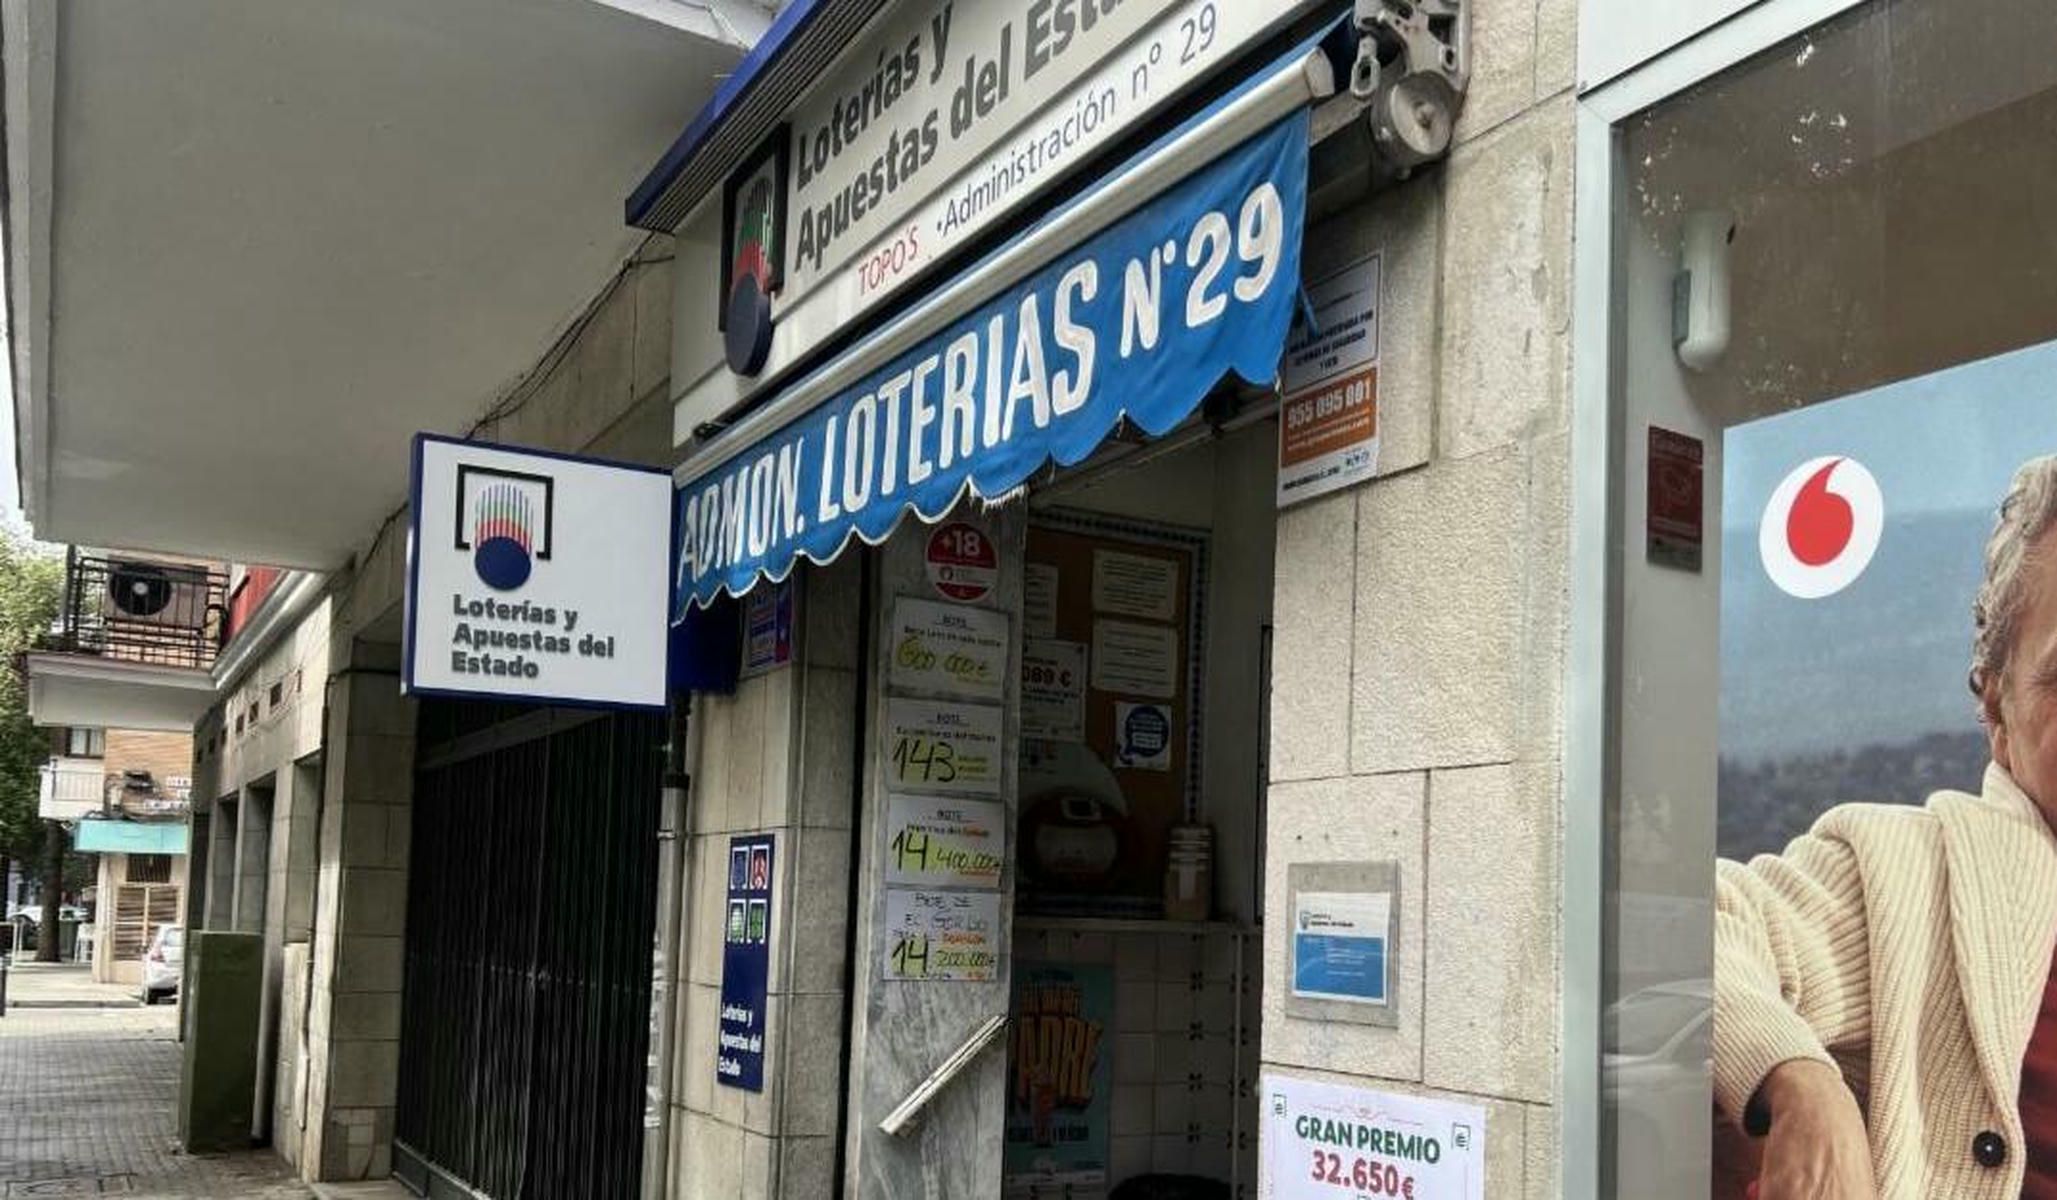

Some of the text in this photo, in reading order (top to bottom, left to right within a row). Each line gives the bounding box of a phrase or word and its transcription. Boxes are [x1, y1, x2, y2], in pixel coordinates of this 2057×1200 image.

[1180, 3, 1217, 67] 29
[797, 3, 953, 191] Loterías y
[795, 105, 938, 273] Apuestas
[950, 22, 1011, 140] del
[676, 436, 805, 589] ADMON.
[818, 258, 1099, 525] LOTERIAS
[1185, 181, 1284, 329] 29
[453, 593, 579, 633] Loterías y
[451, 650, 540, 679] Estado
[452, 622, 615, 658] Apuestas del
[892, 738, 956, 783] 143
[1295, 1114, 1441, 1165] GRAN PREMIO
